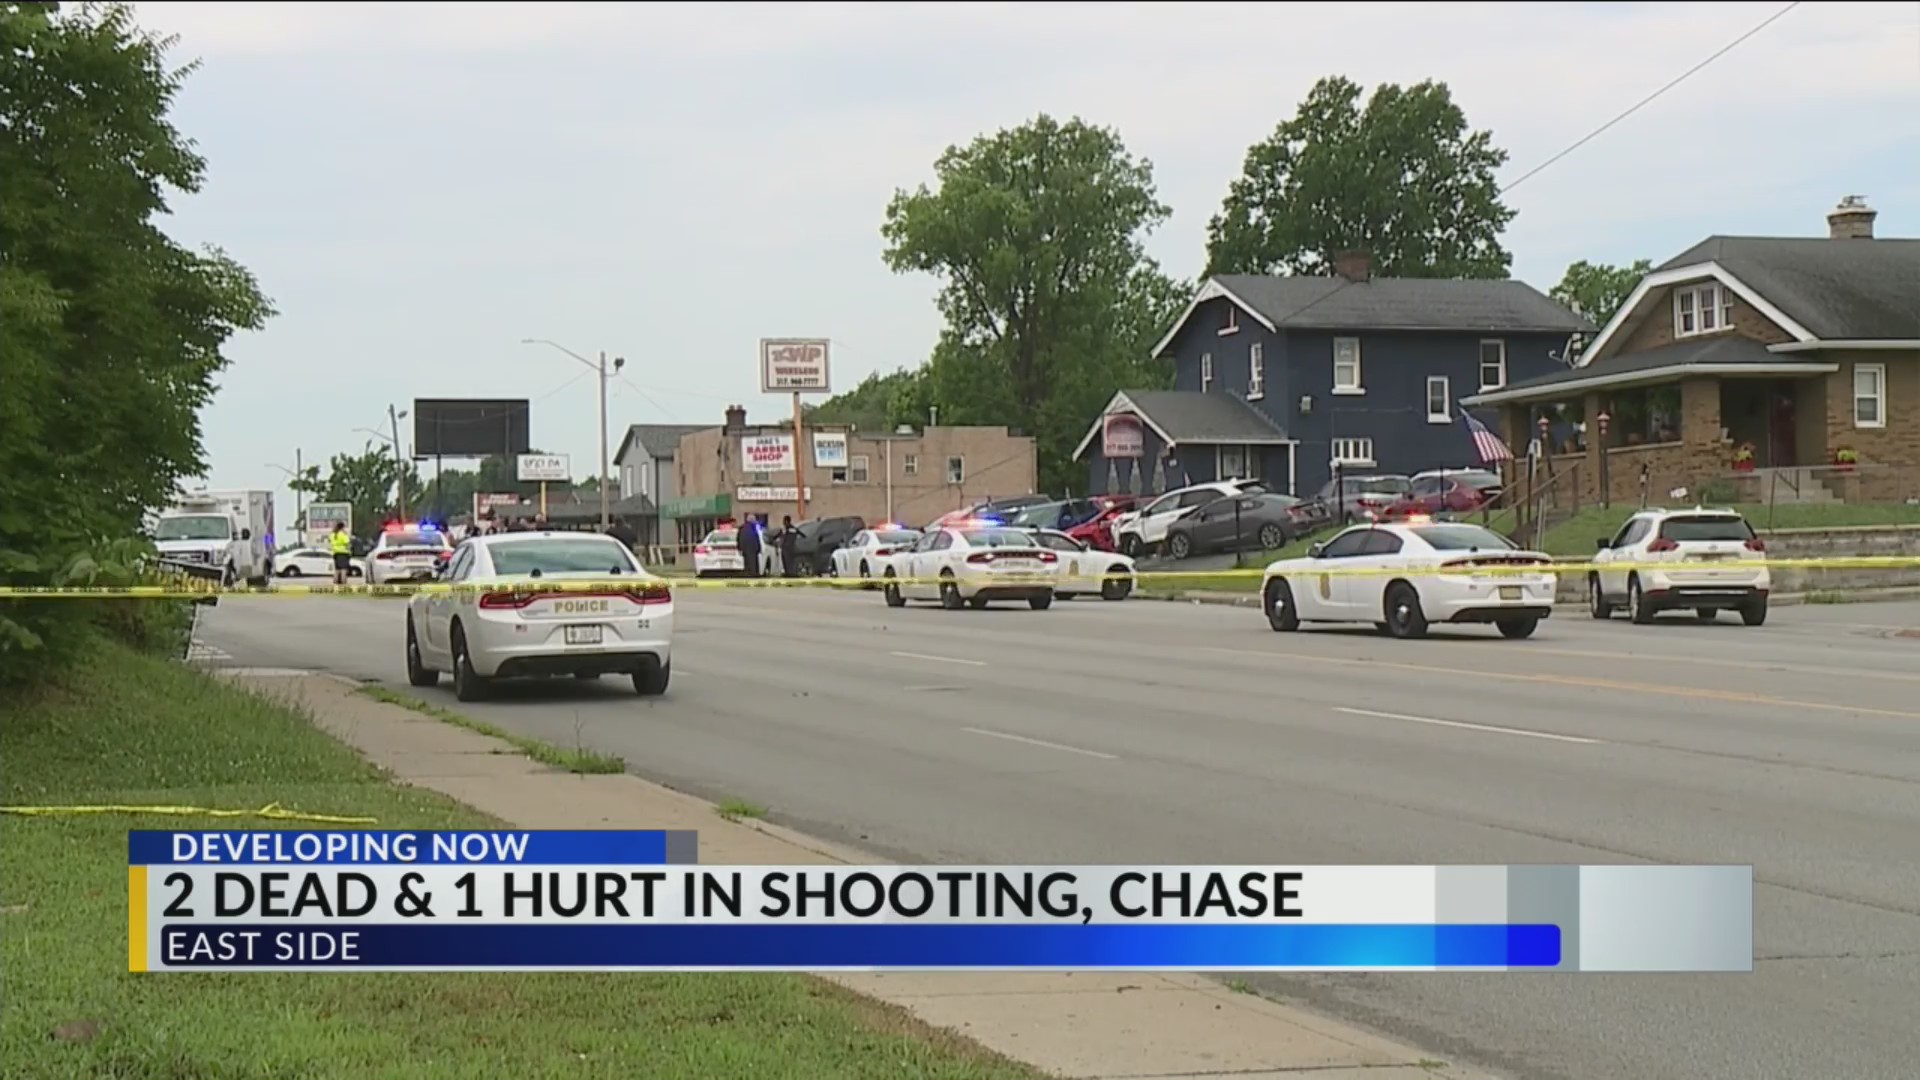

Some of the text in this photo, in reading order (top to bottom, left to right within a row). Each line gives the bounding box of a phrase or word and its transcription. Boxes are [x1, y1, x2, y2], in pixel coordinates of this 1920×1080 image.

[747, 445, 789, 454] BARBER
[753, 453, 782, 461] SHOP
[554, 600, 609, 612] POLICE
